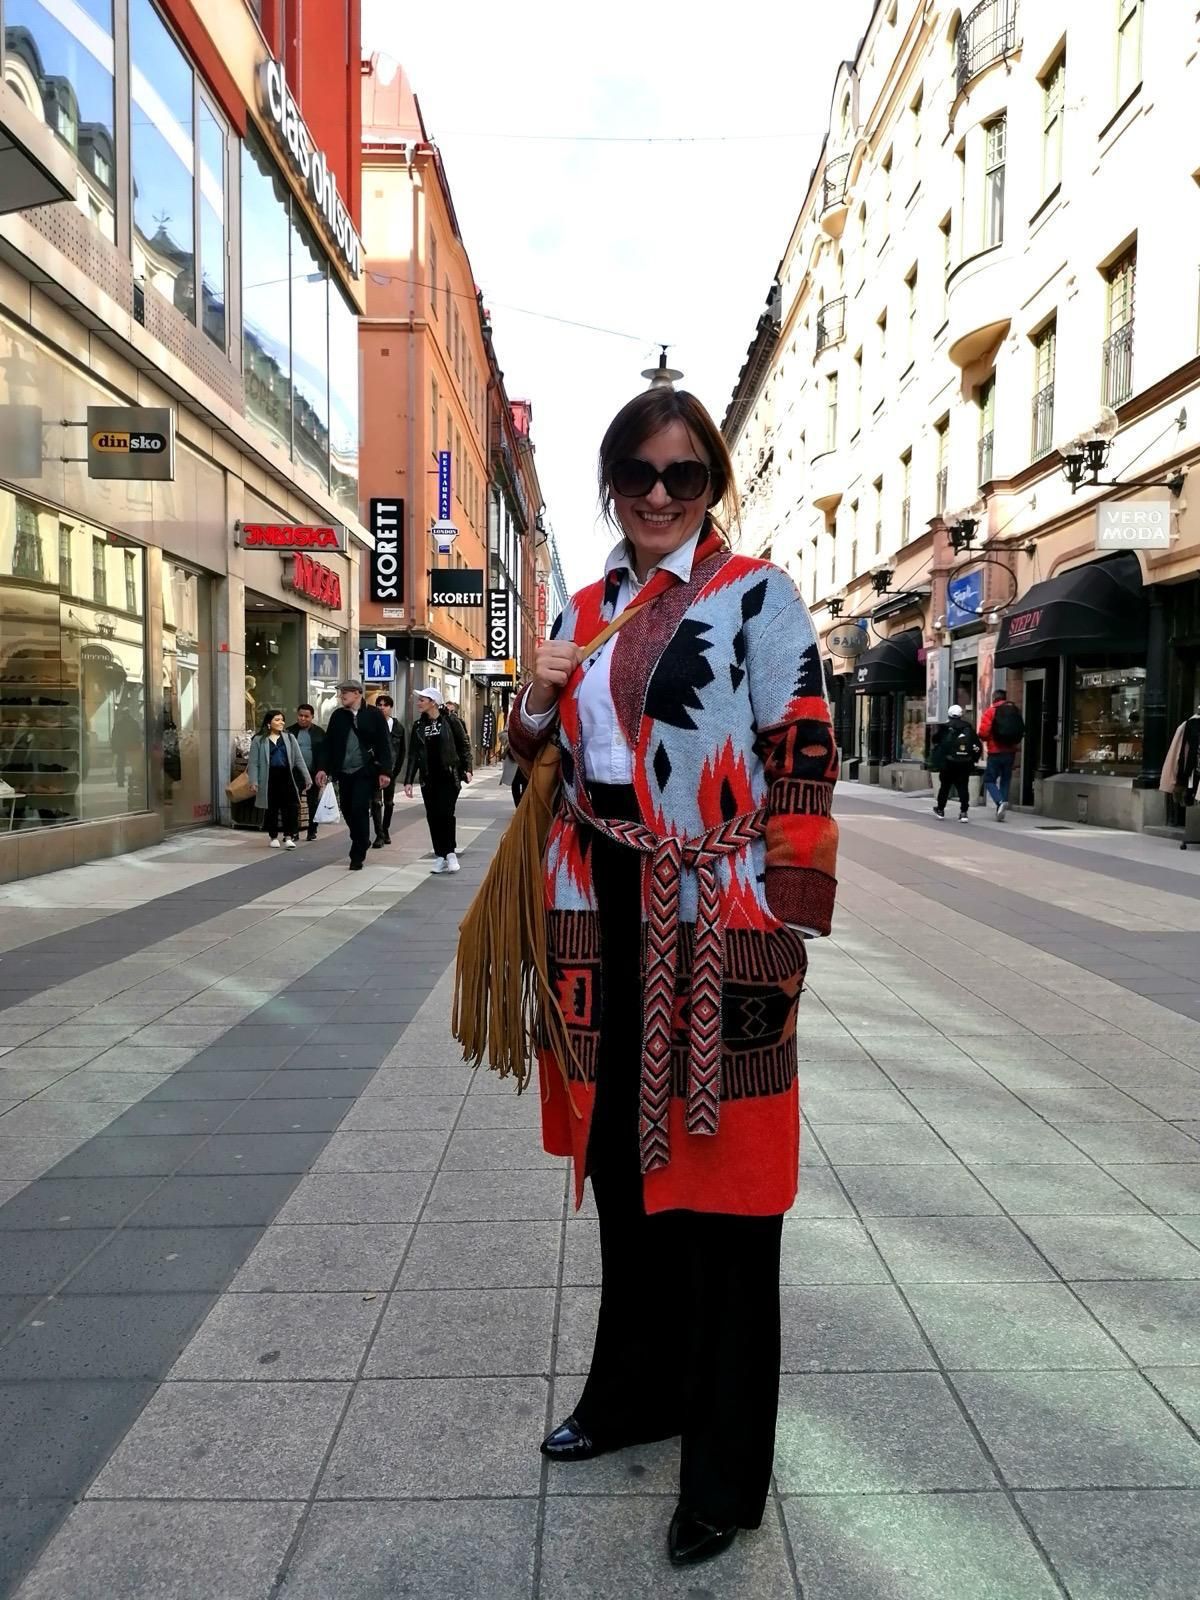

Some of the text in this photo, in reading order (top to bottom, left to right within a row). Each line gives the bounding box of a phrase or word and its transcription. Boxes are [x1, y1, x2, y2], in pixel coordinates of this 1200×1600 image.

[265, 60, 360, 280] clas ohlson
[98, 434, 161, 450] dinsko
[1106, 510, 1162, 524] VERO
[1102, 527, 1165, 540] MODA
[376, 502, 398, 598] SCORETT
[433, 592, 482, 604] SCORETT
[490, 592, 507, 657] SCORETT
